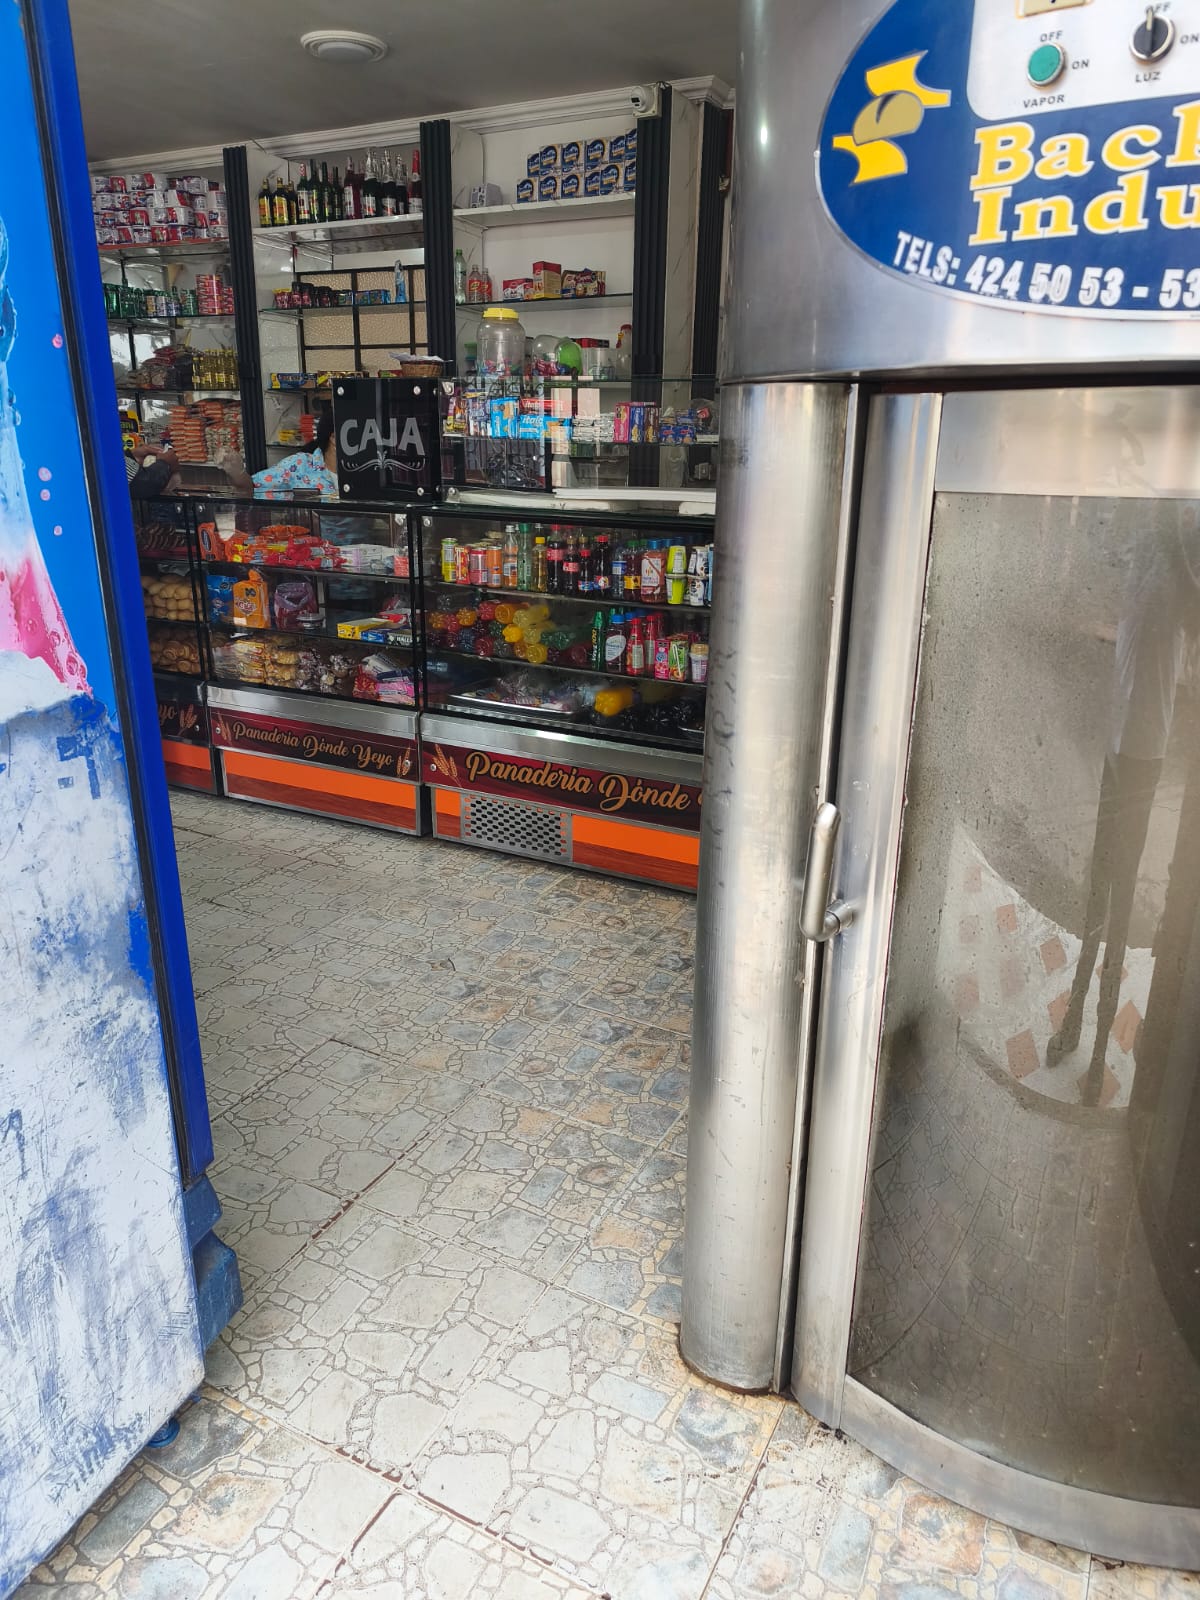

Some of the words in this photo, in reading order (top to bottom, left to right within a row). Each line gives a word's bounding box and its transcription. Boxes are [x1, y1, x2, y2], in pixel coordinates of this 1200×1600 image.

[1040, 30, 1063, 42] OFF
[1180, 33, 1200, 45] ON
[1071, 59, 1090, 70] ON
[1135, 71, 1162, 83] LUZ
[1023, 94, 1065, 109] VAPOR
[893, 230, 961, 286] TELS:
[964, 254, 1024, 298] 424
[1028, 262, 1073, 304] 50
[1078, 266, 1125, 307] 53
[340, 417, 426, 457] CAJA
[351, 744, 394, 769] Yeyo
